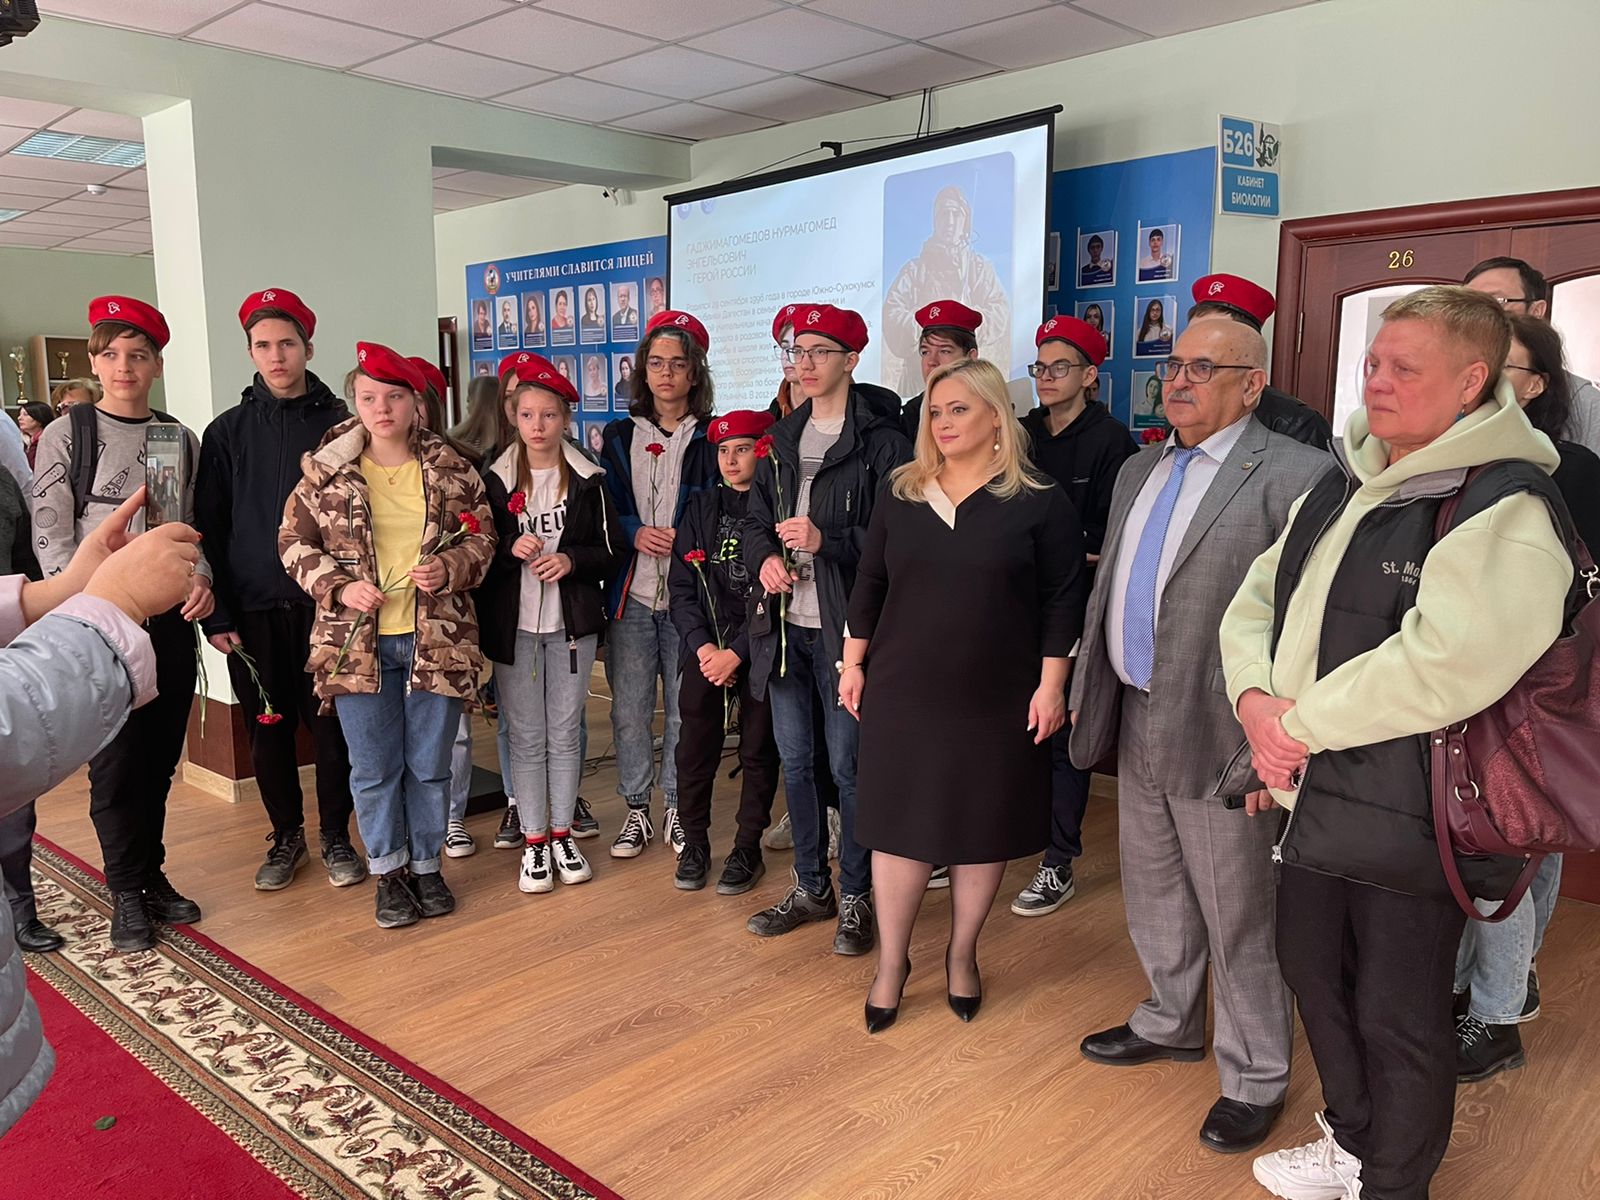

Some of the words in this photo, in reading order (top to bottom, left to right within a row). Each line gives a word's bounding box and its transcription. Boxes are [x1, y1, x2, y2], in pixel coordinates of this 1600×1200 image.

[1223, 128, 1254, 157] Б26
[1237, 175, 1265, 188] КАБИНЕТ
[1231, 191, 1271, 208] БИОЛОГИИ
[686, 229, 771, 254] ГАДЖИМАГОМЕДОВ
[772, 216, 837, 239] НУРМАГОМЕД
[505, 265, 560, 283] УЧИТЕЛЯМИ
[561, 258, 614, 275] СЛАВИТСЯ
[616, 251, 654, 269] ЛИЦЕЙ
[687, 250, 747, 270] ЭНГЕЛЬСОВИЧ
[1388, 249, 1414, 269] 26
[692, 269, 719, 284] ГЕРОЙ
[720, 264, 757, 280] РОССИИ
[787, 288, 810, 299] городе
[812, 280, 875, 295] Южно-Сухокумск
[1382, 561, 1400, 575] St.
[1402, 560, 1421, 577] Mo
